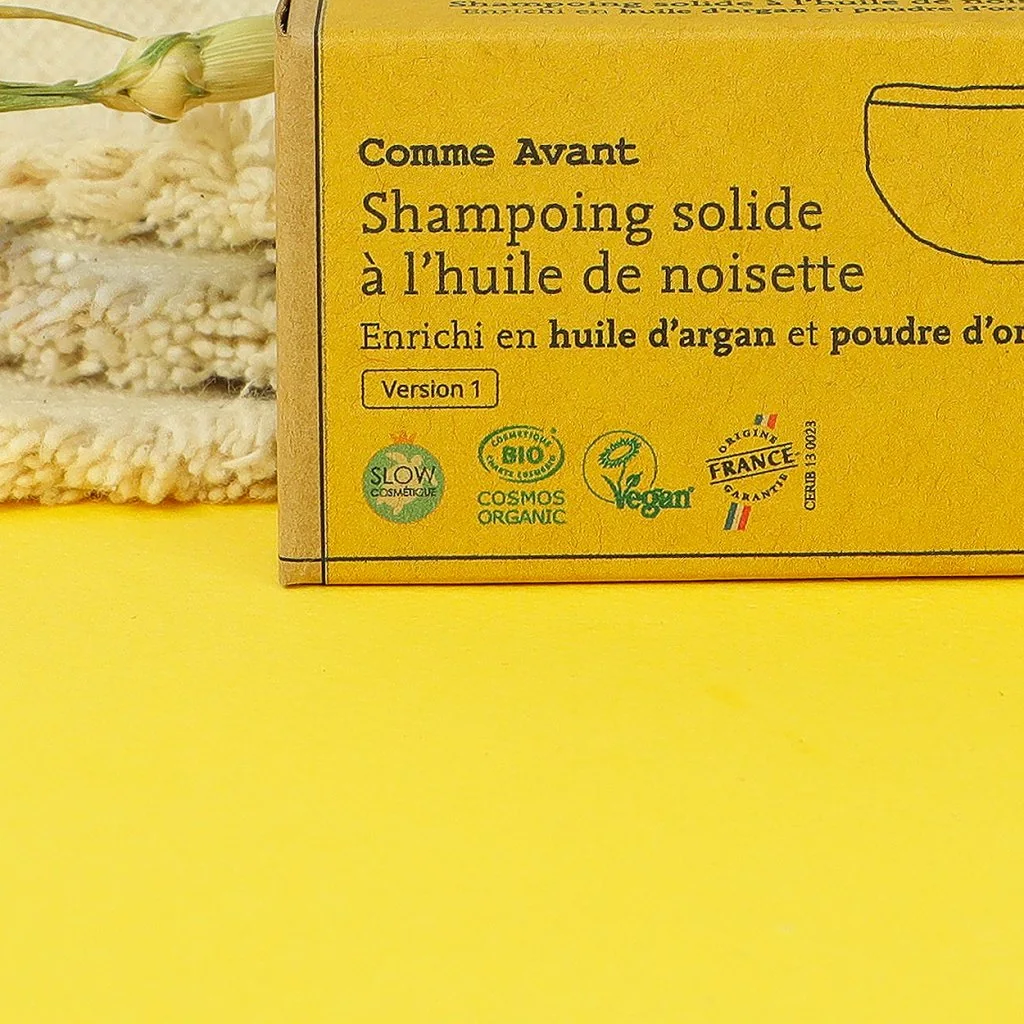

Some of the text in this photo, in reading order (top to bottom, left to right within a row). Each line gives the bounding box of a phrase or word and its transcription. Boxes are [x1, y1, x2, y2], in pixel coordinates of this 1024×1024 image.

[449, 0, 642, 9] Shampoing
[654, 0, 753, 8] solide
[462, 7, 565, 15] Enrichi
[620, 7, 692, 15] huile
[854, 5, 954, 15] poudre
[358, 136, 640, 168] Comme Avant
[362, 185, 823, 246] Shampoing solide
[361, 251, 386, 296] à
[583, 249, 641, 294] de
[660, 252, 864, 294] noisette
[360, 319, 484, 350] Enrichi
[496, 329, 538, 350] en
[548, 318, 637, 349] huile
[787, 321, 819, 347] et
[829, 315, 951, 356] poudre
[381, 379, 480, 399] Version 1
[718, 427, 779, 453] ORIGINE
[502, 445, 544, 465] BIO
[706, 446, 796, 481] FRANCE
[803, 419, 817, 512] CERIB 13 0023
[370, 465, 436, 486] SLOW
[723, 473, 789, 502] GARANTIE
[370, 485, 438, 498] COSMÉTIQUE
[477, 490, 566, 507] COSMOS
[609, 480, 692, 519] Vegan
[477, 509, 567, 526] ORGANIC
